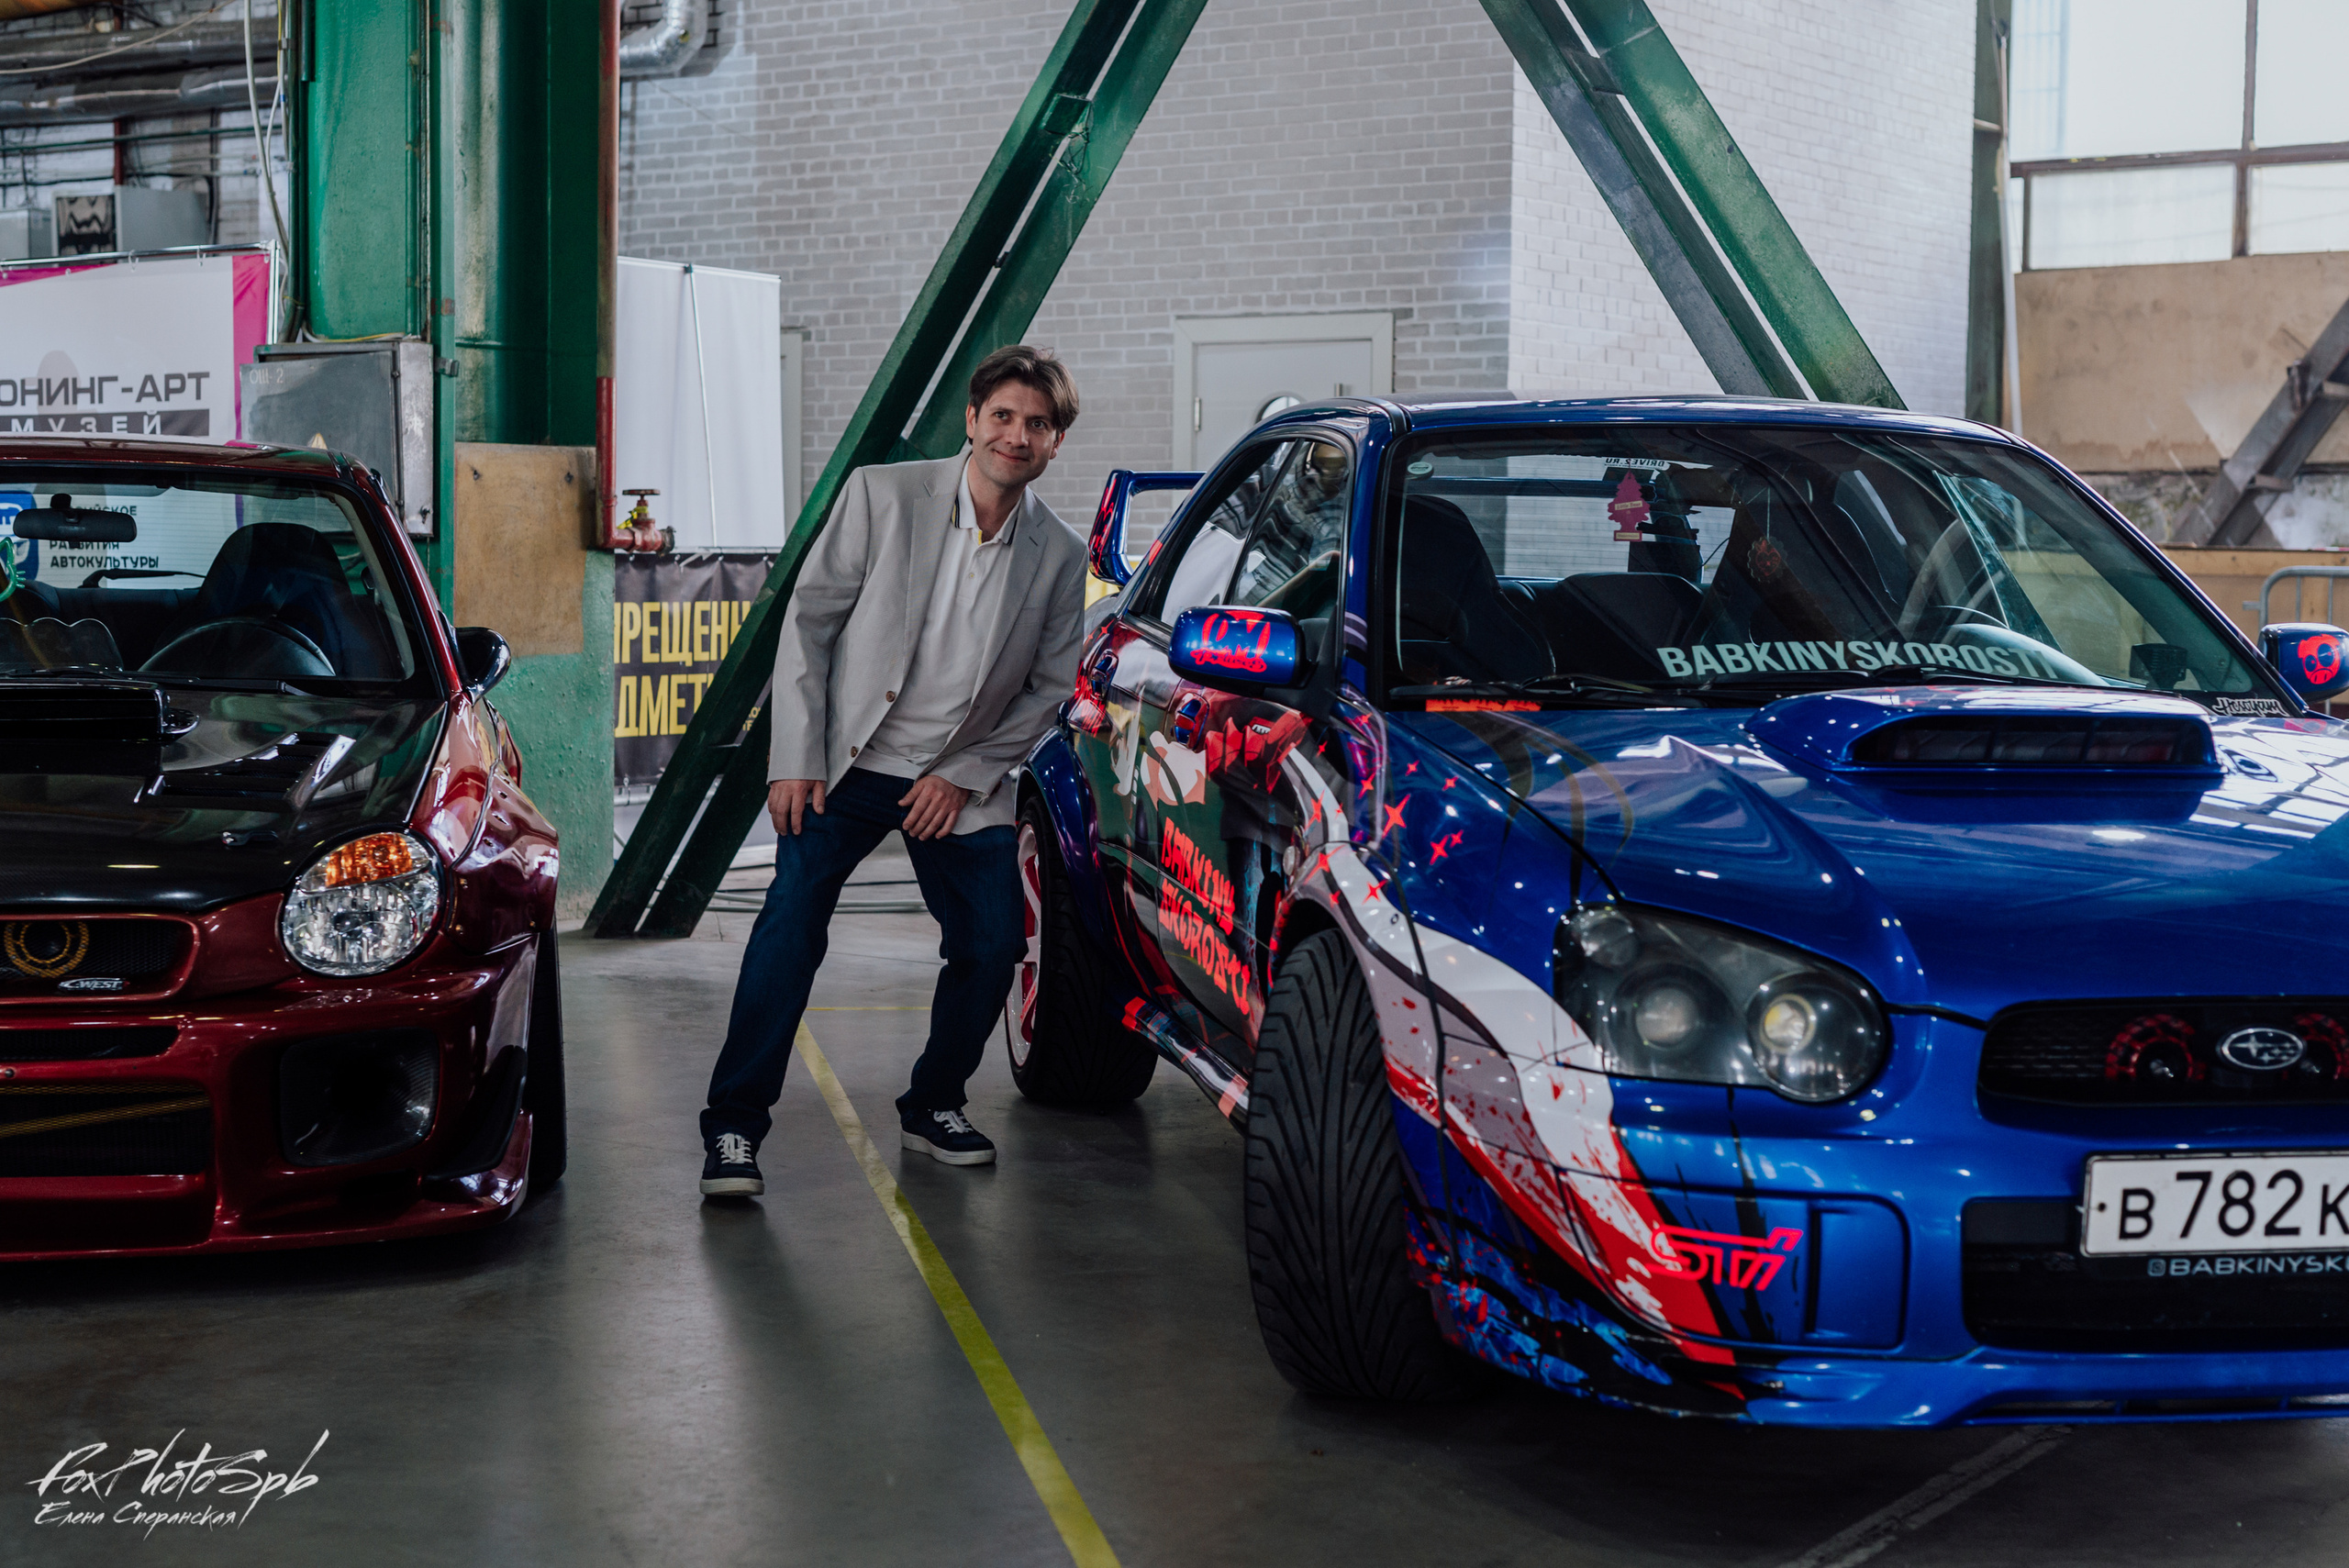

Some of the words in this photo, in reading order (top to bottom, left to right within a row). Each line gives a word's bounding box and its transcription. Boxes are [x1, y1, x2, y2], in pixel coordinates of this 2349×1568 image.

[11, 409, 161, 435] МУЗЕЙ
[50, 540, 119, 550] РАВИТИЯ
[50, 556, 160, 568] АВТОКУЛЬТУРЫ
[1656, 640, 2058, 678] BABKINYSKOROSTI
[615, 673, 714, 738] ДМЕТ
[2169, 1255, 2349, 1276] BABKINYSK
